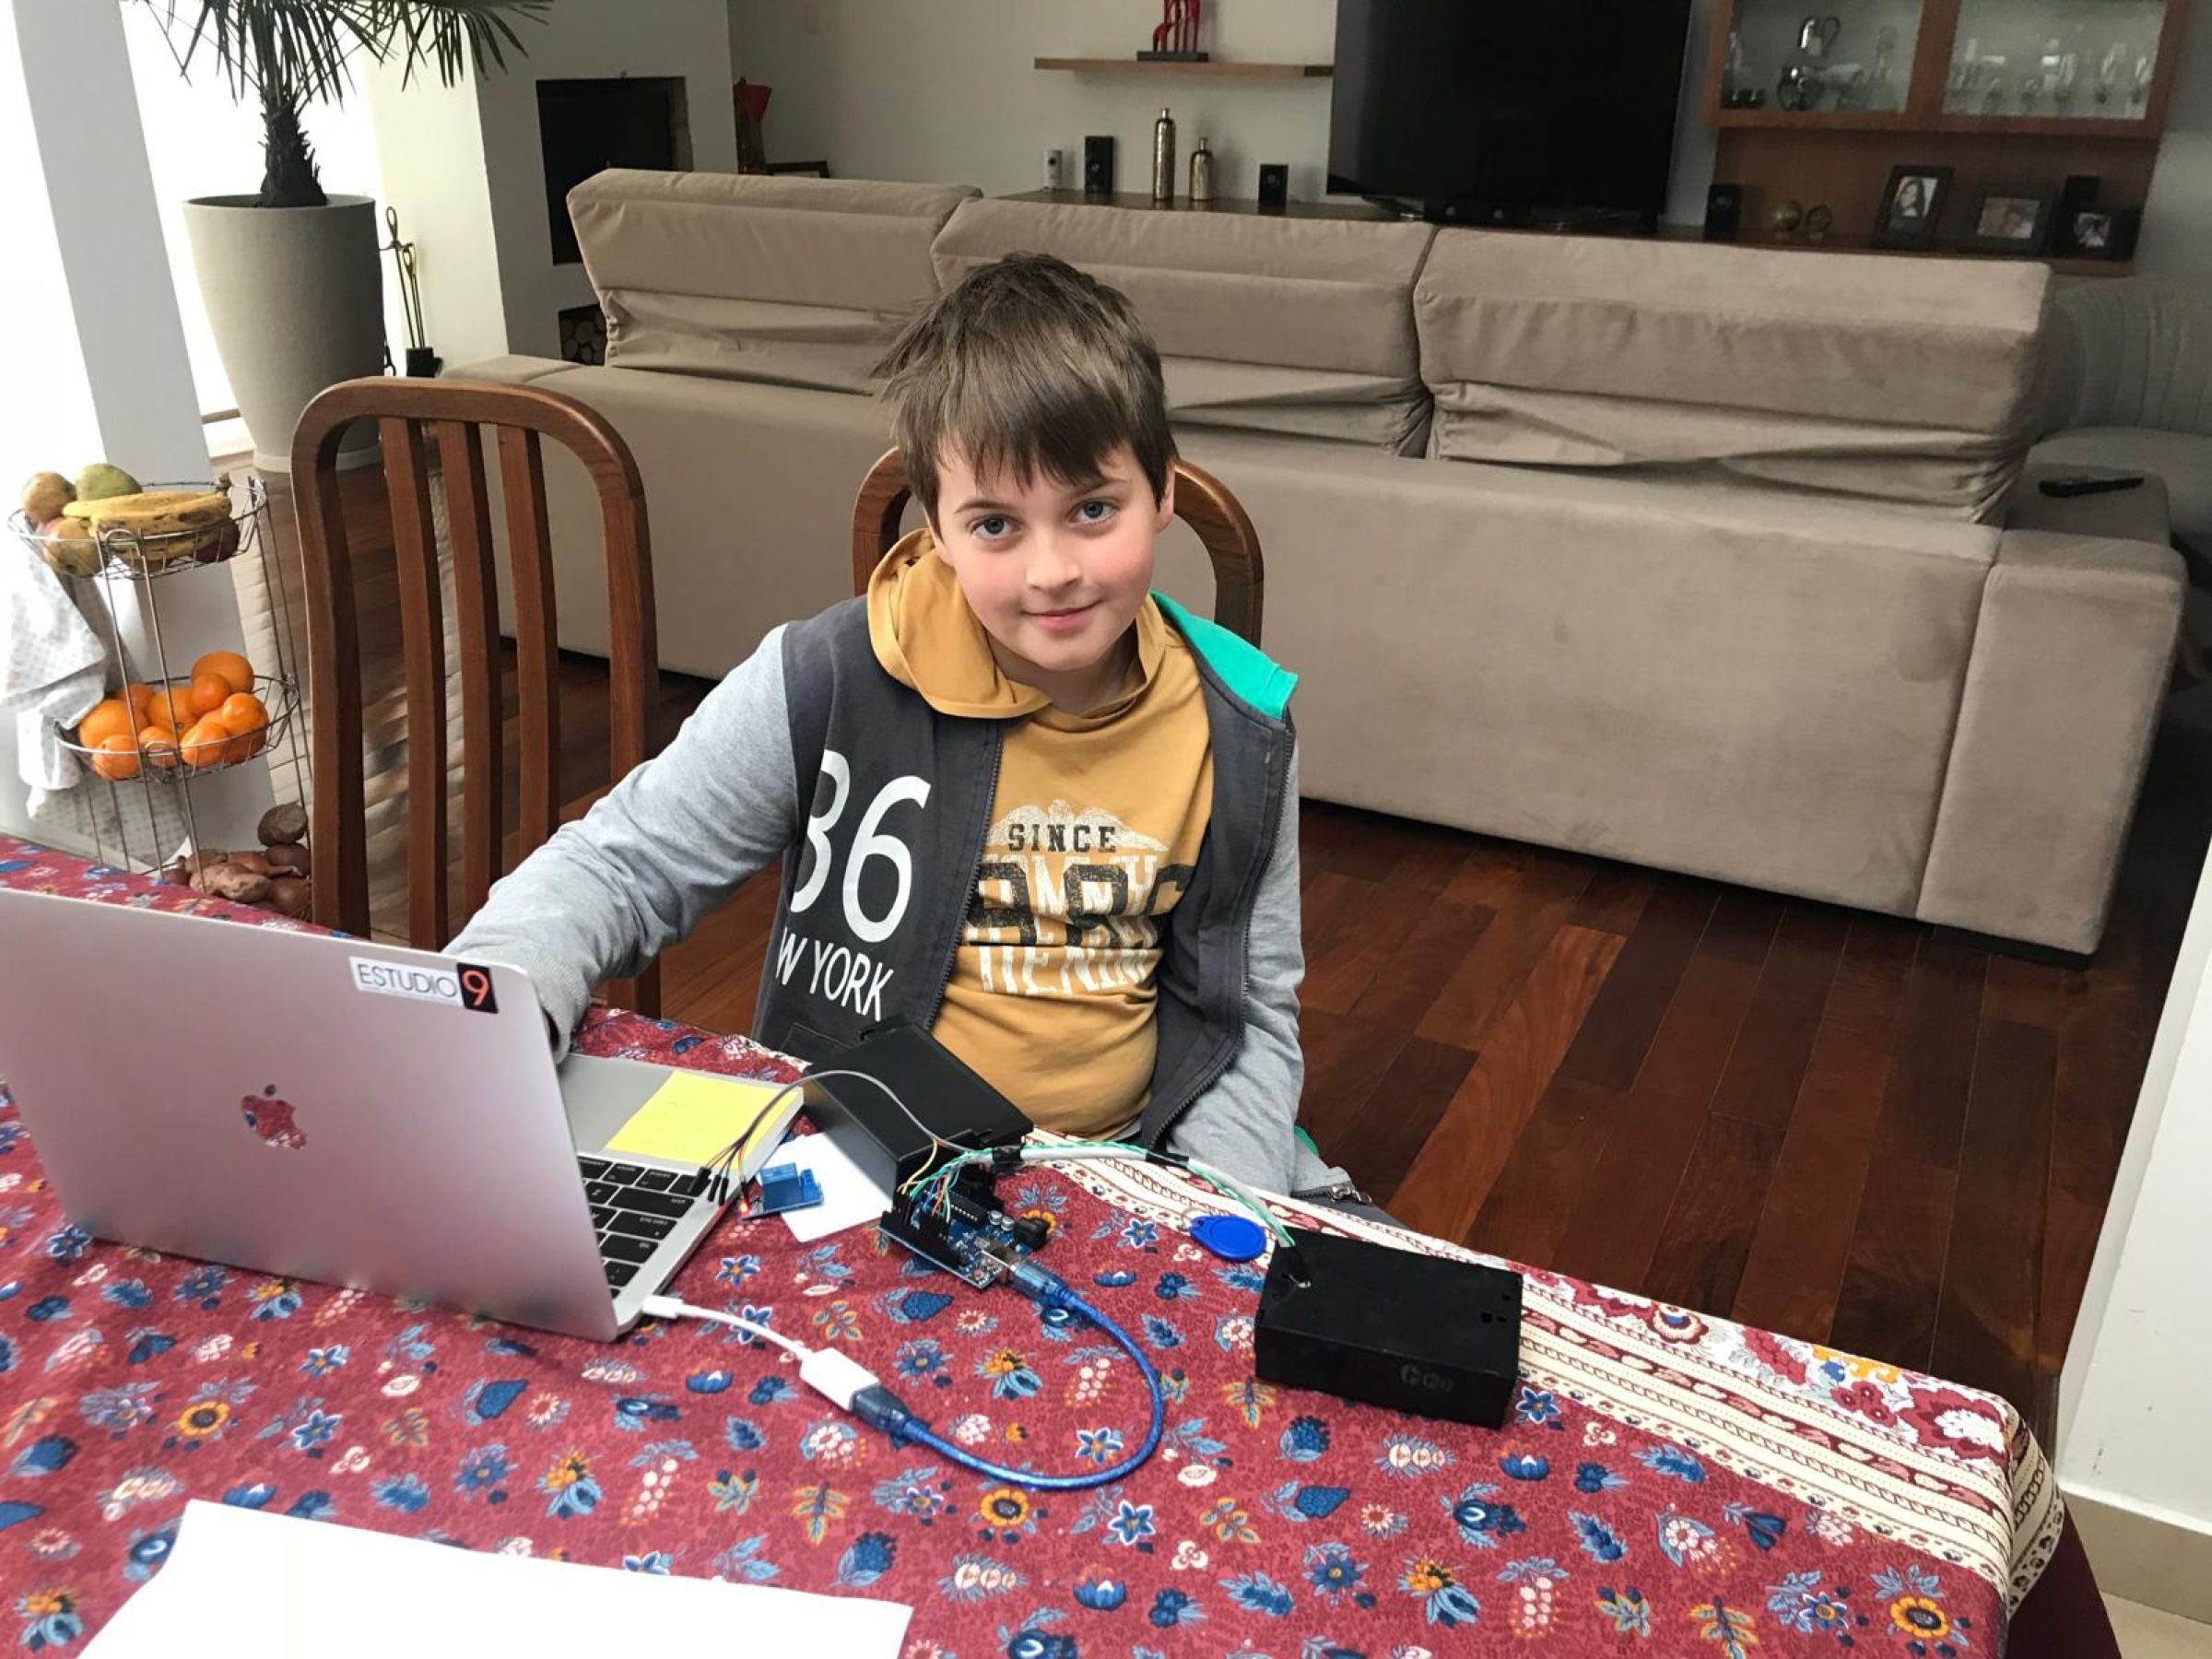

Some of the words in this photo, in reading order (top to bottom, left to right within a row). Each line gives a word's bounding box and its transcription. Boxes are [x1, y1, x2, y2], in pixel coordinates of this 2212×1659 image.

[1008, 823, 1116, 852] SINCE
[357, 964, 457, 997] ESTUDIO
[462, 970, 489, 1006] 9
[809, 939, 894, 1021] YORK
